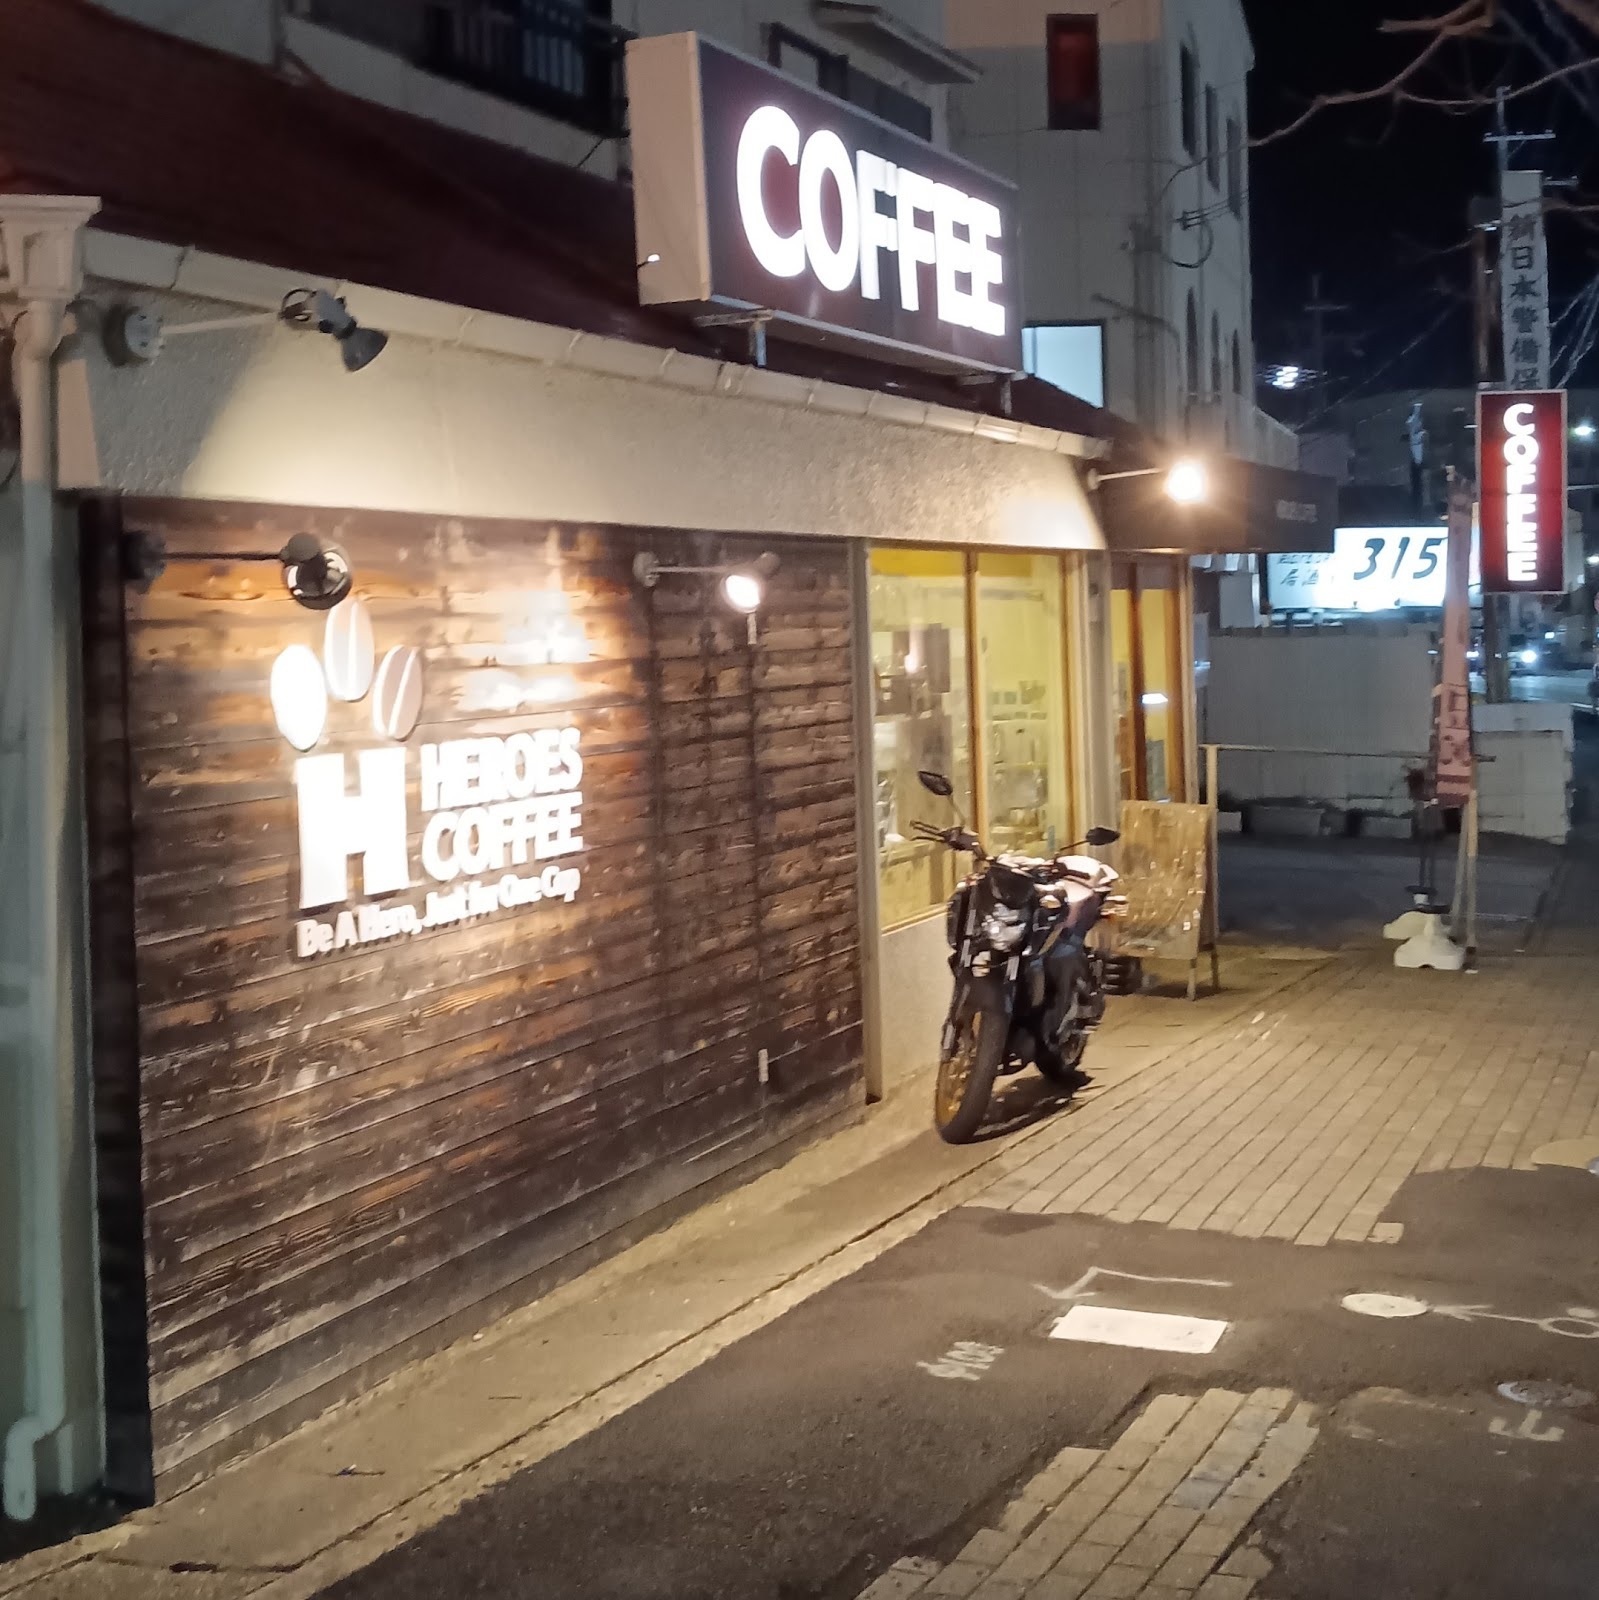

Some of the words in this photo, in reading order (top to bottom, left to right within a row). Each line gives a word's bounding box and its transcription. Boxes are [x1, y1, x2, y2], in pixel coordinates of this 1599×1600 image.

[736, 105, 1005, 336] COFFEE
[1503, 403, 1539, 582] COFFEE
[1353, 537, 1442, 580] 315
[420, 728, 583, 812] HEROES
[295, 747, 408, 909] H
[422, 791, 583, 881] COFFEE
[297, 919, 334, 957] Be
[334, 911, 359, 948] A
[422, 891, 468, 927] Just
[500, 874, 542, 908] One
[541, 866, 580, 902] Cup
